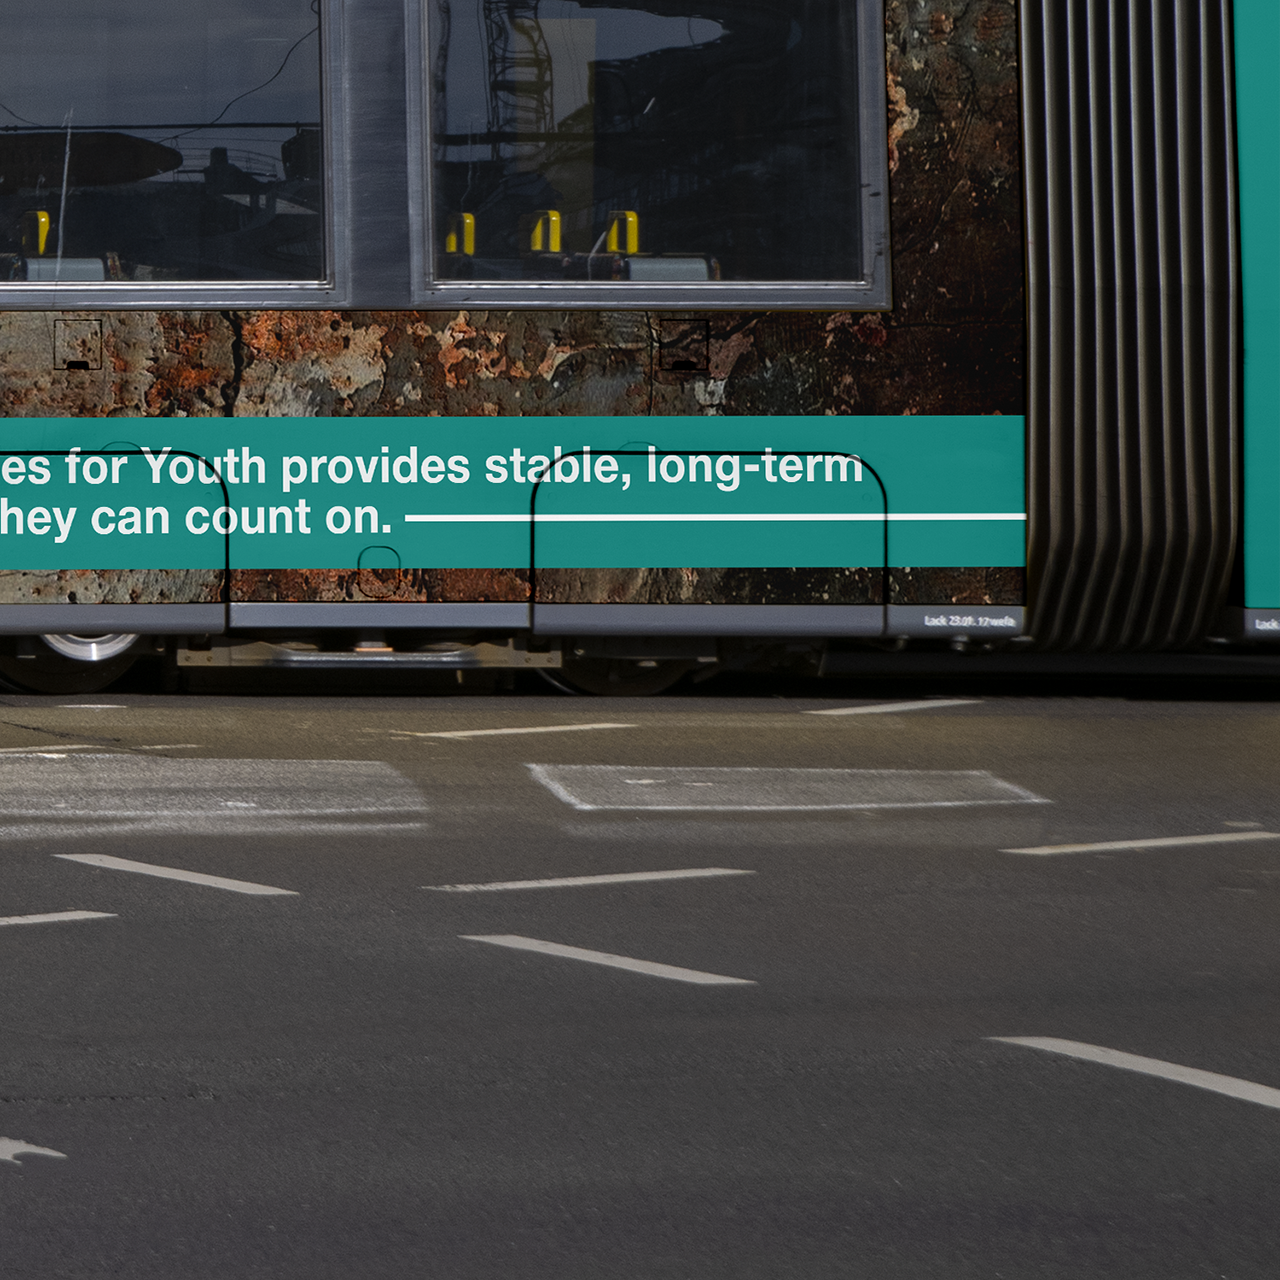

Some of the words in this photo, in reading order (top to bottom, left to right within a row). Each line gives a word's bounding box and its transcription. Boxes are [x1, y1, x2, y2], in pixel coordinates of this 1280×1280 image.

[64, 446, 128, 485] for
[140, 446, 266, 485] Youth
[282, 446, 470, 493] provides
[485, 445, 631, 491] stable,
[648, 445, 863, 494] long-term
[91, 506, 169, 535] can
[185, 498, 311, 535] count
[325, 505, 391, 535] on.
